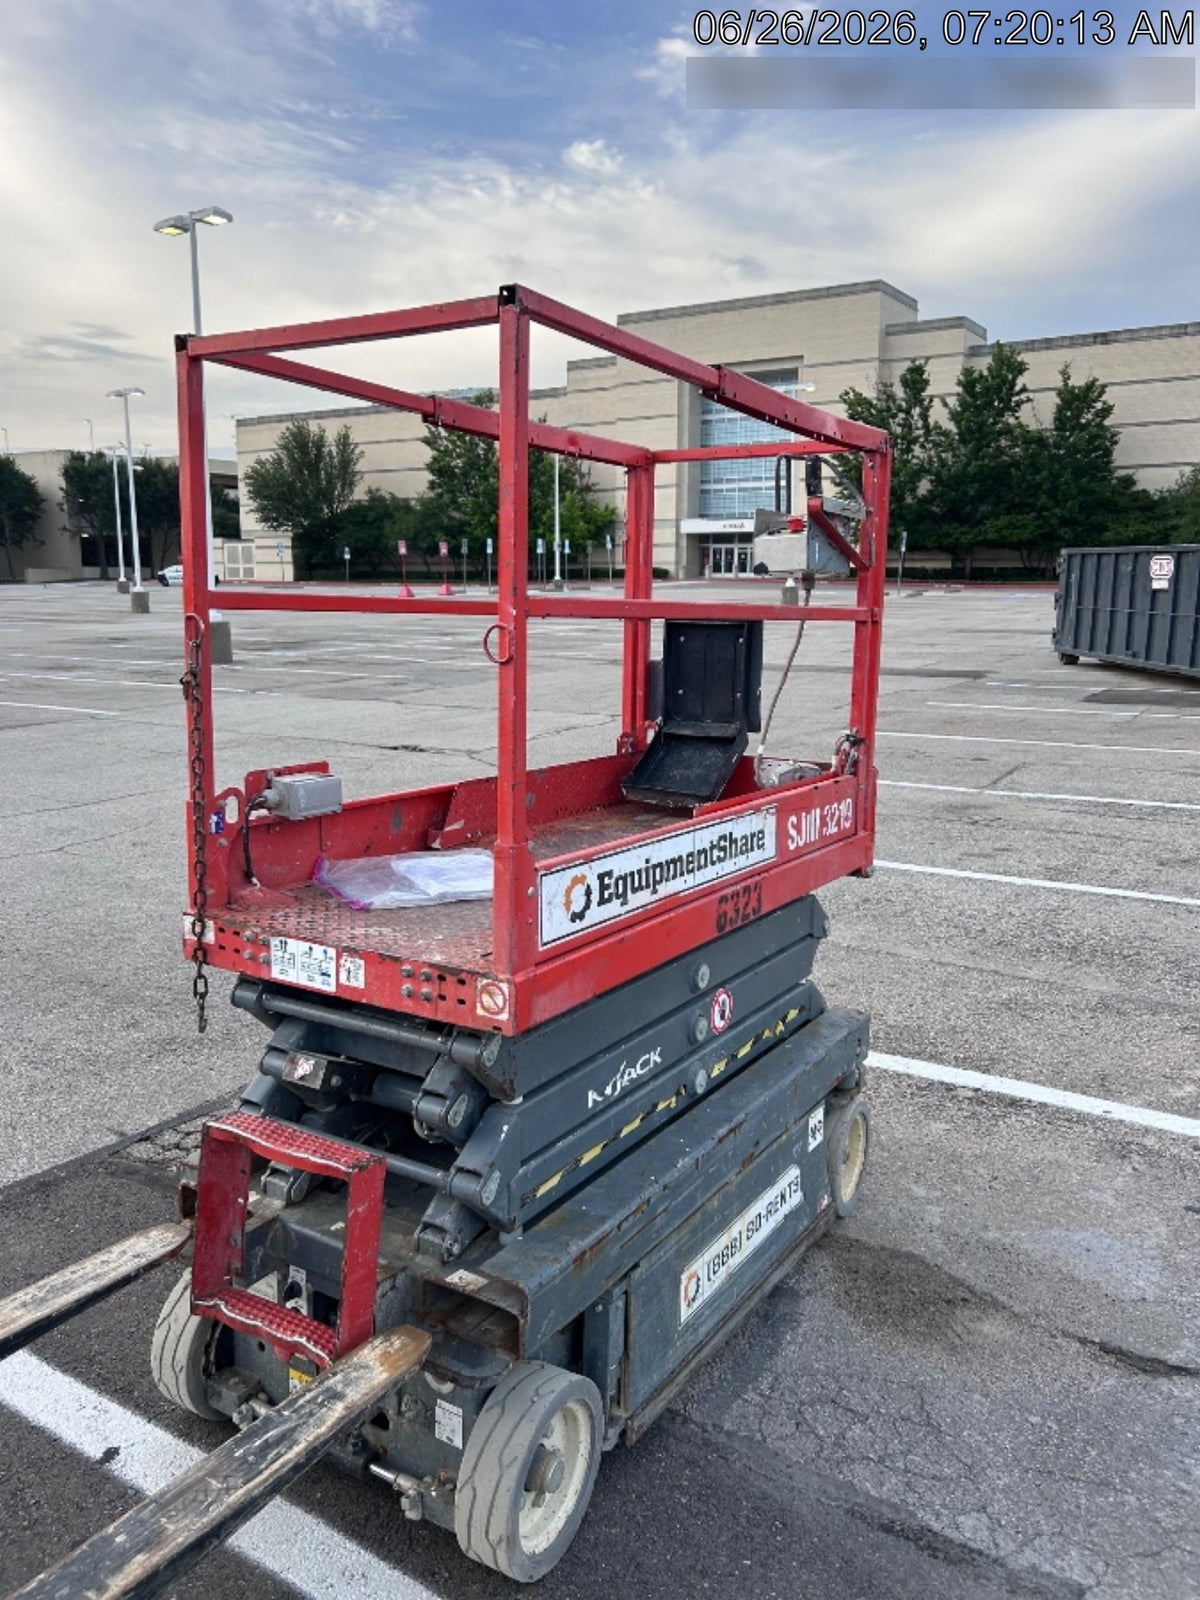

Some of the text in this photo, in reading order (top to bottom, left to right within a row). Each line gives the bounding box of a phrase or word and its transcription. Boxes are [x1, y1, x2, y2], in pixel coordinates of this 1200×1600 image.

[822, 798, 853, 837] 3219
[597, 828, 766, 907] EquipmentShare
[716, 882, 762, 934] 6323
